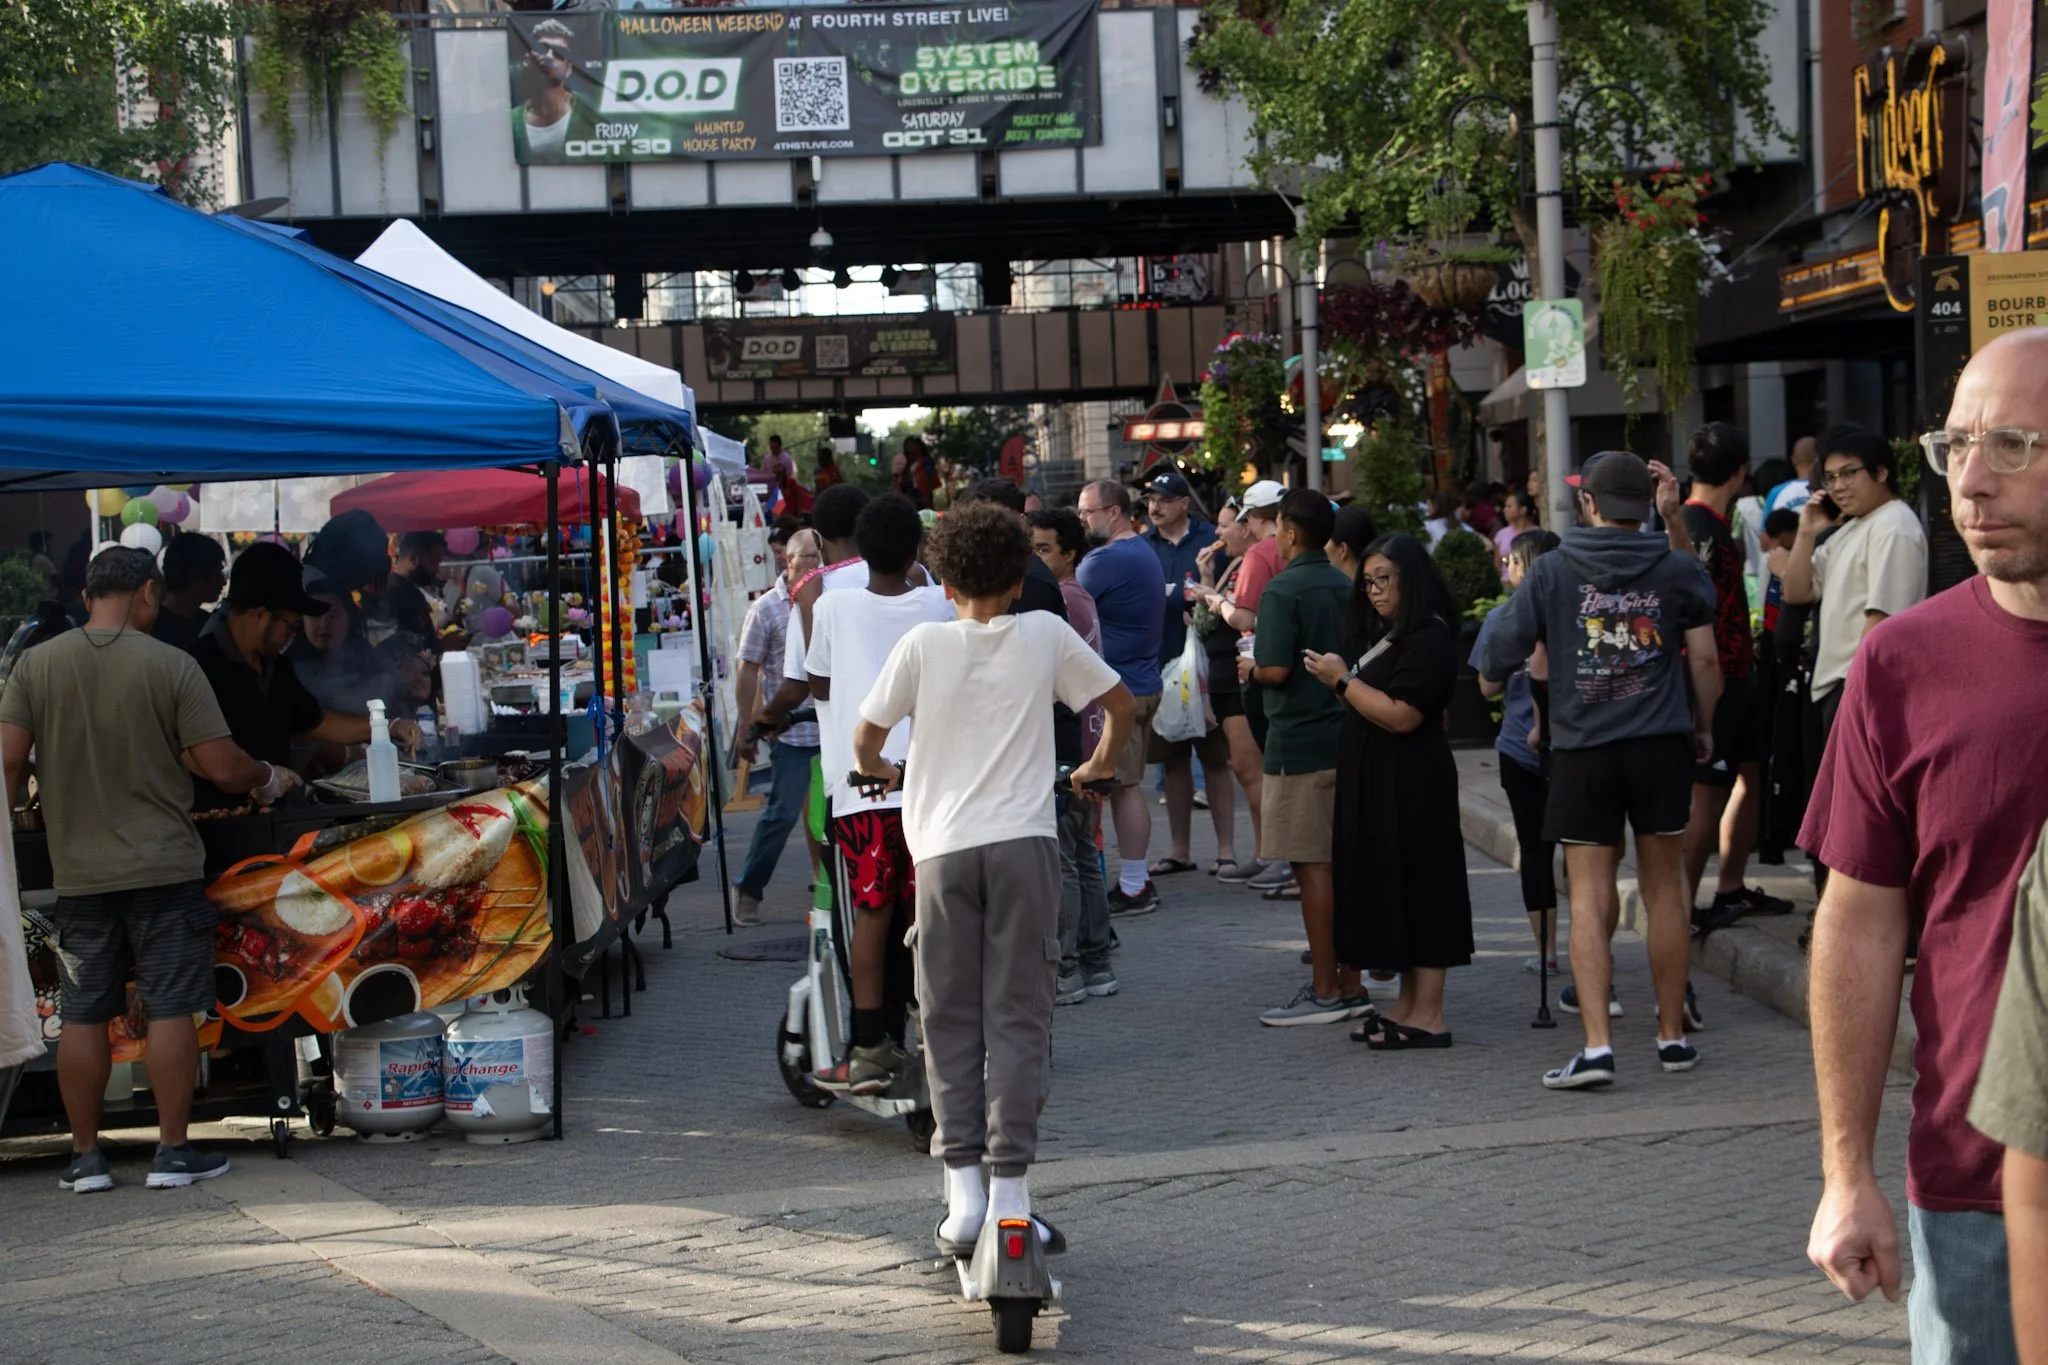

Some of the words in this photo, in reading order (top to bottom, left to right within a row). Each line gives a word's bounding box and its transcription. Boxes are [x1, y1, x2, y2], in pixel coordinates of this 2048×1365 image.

[620, 16, 712, 36] HALLOWEEN
[715, 14, 784, 32] WEEKEND
[788, 16, 802, 30] AT
[811, 12, 886, 28] FOURTH
[892, 11, 962, 26] STREET
[967, 7, 1009, 23] LIVE!
[916, 41, 1039, 68] SYSTEM
[616, 70, 727, 101] D.O.D
[900, 65, 1056, 94] OVERRIDE
[694, 121, 744, 135] HAUNTED
[901, 111, 966, 129] SATURDAY
[595, 123, 639, 139] FRIDAY
[883, 130, 944, 147] OCT
[949, 128, 987, 144] 31
[565, 140, 626, 157] OCT
[631, 139, 672, 154] 30
[683, 138, 719, 152] HOUSE
[722, 137, 757, 152] PARTY
[773, 140, 854, 150] 4THSTLIVE.COM
[1931, 301, 1961, 316] 404
[1988, 313, 2036, 328] DISTR
[1617, 592, 1660, 613] Girls
